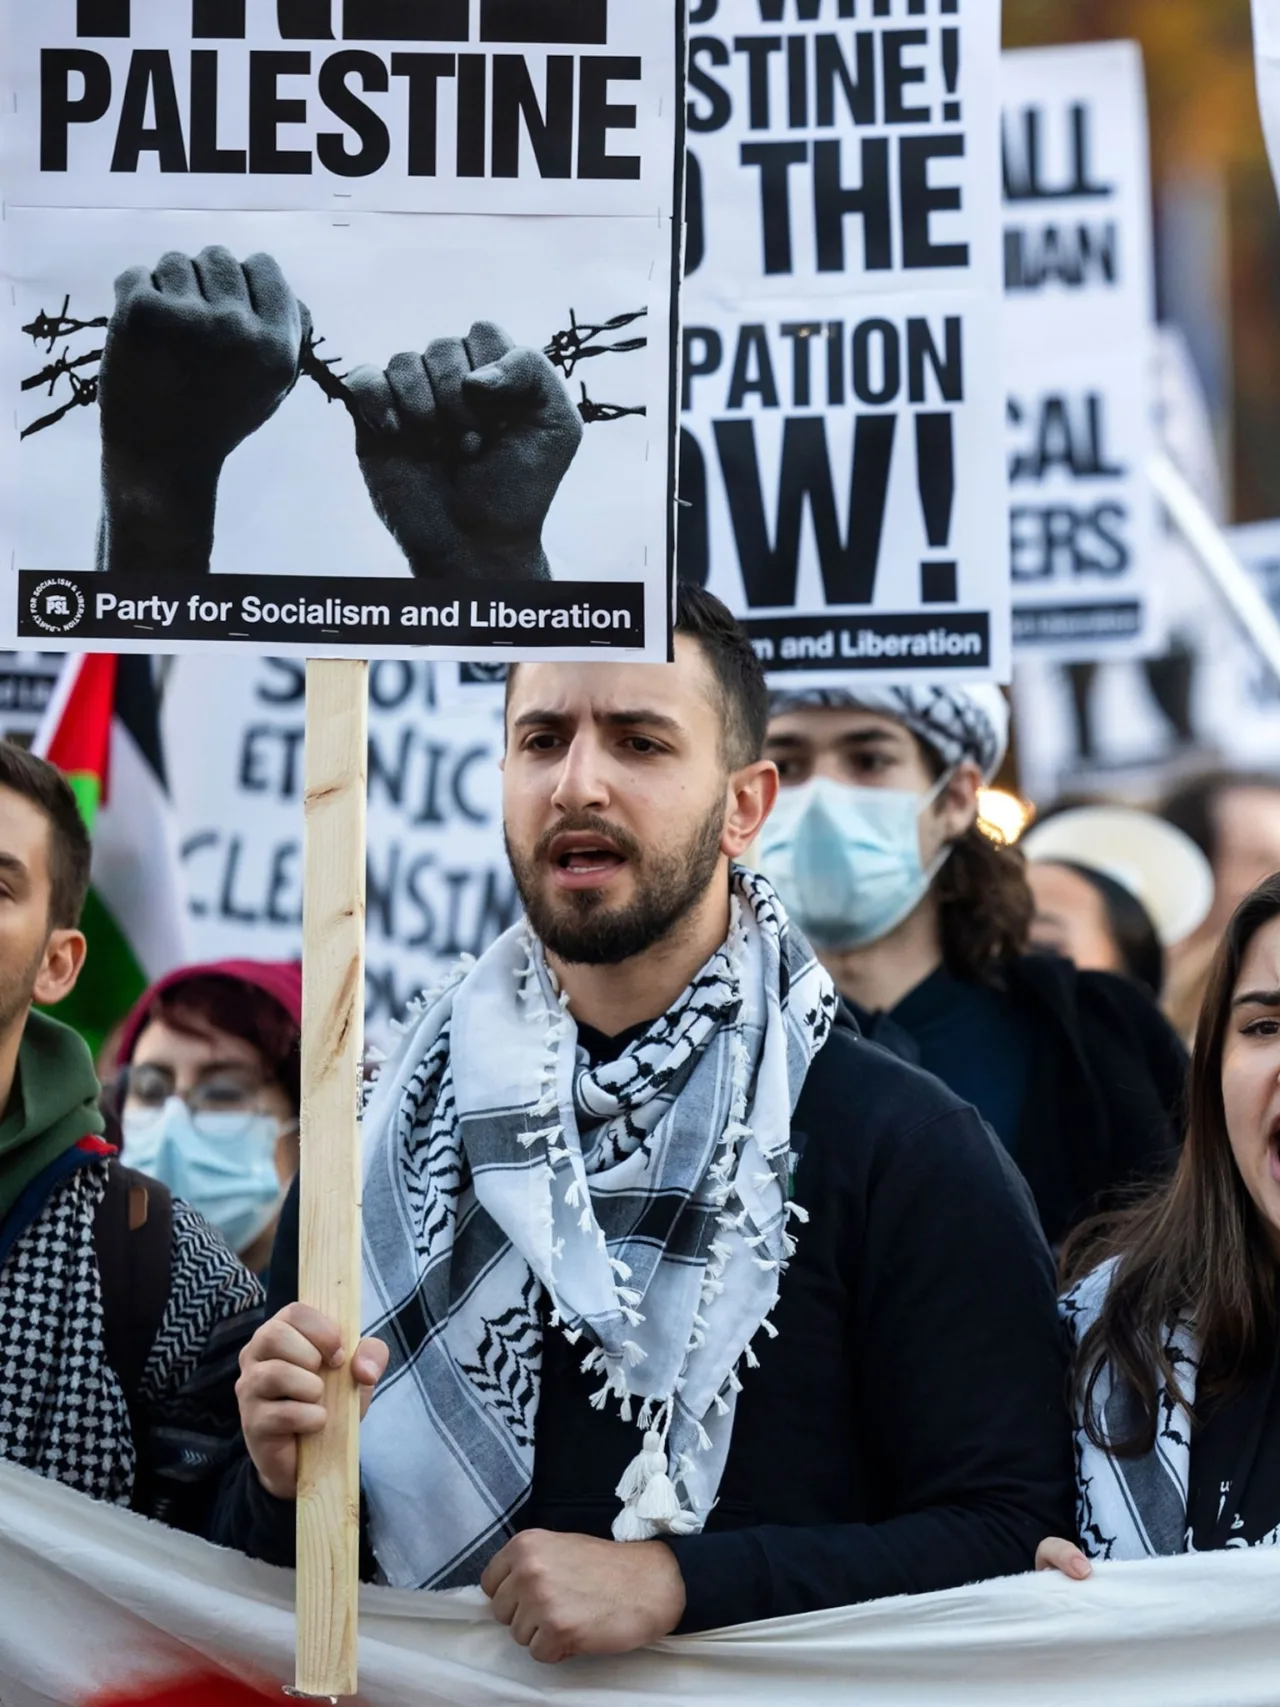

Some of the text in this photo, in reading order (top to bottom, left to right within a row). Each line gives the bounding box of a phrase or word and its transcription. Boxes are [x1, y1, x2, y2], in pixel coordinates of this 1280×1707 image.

[40, 48, 642, 180] PALESTINE
[685, 27, 962, 133] STINE!
[740, 134, 970, 276] THE
[680, 315, 963, 411] PATION
[46, 598, 70, 615] PSL
[96, 593, 631, 629] Party for Socialism and Liberation
[779, 630, 835, 659] and
[839, 627, 982, 658] Liberation
[241, 726, 488, 824] ETNIC
